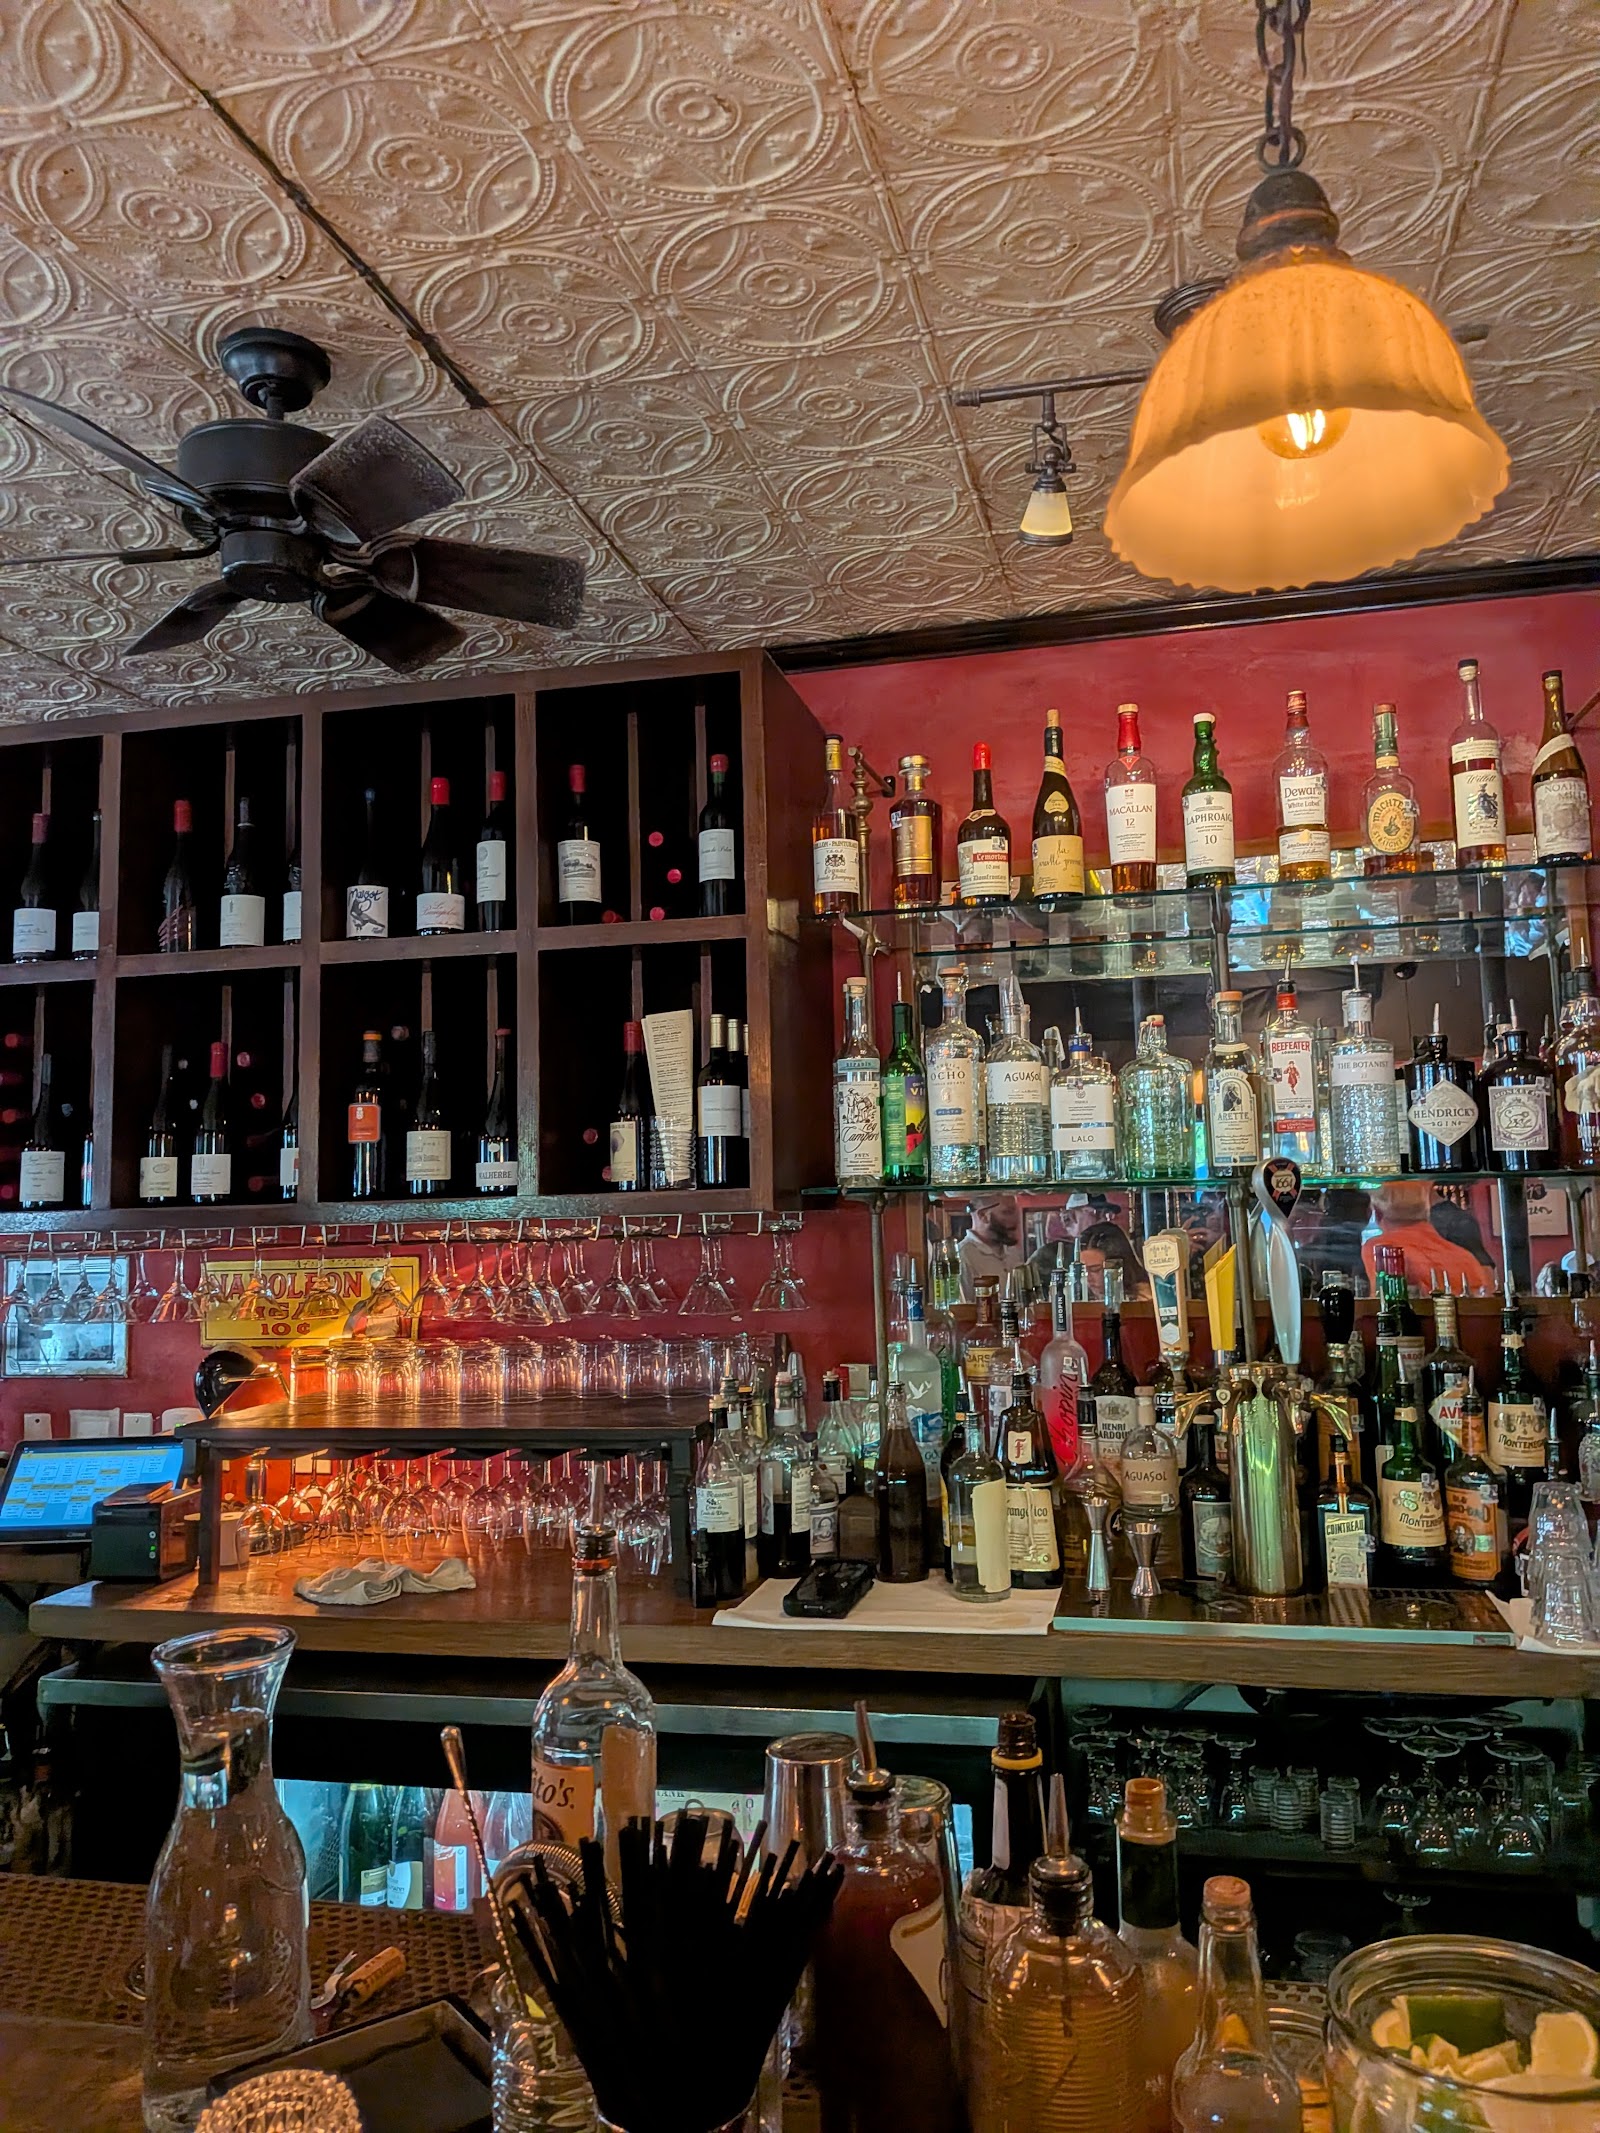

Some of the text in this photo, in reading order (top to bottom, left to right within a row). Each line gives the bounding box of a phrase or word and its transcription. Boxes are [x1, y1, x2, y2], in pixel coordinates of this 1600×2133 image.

[1109, 805, 1153, 816] MACALLAN
[1126, 818, 1135, 826] 12
[1204, 834, 1217, 845] 10
[1271, 1041, 1310, 1054] BEEFEATER
[1337, 1060, 1389, 1070] THE BOTANIST
[930, 1070, 966, 1081] OCHO
[1218, 1111, 1250, 1121] ARETTE
[1413, 1108, 1475, 1118] HENDRICK'S
[1072, 1135, 1094, 1143] LALO
[261, 1323, 291, 1336] 10
[1102, 1423, 1126, 1431] HENRI
[1125, 1471, 1167, 1483] AGUASOL
[1007, 1504, 1048, 1519] rangico
[1326, 1520, 1364, 1536] COINTREAU
[533, 1769, 575, 1809] ito's.
